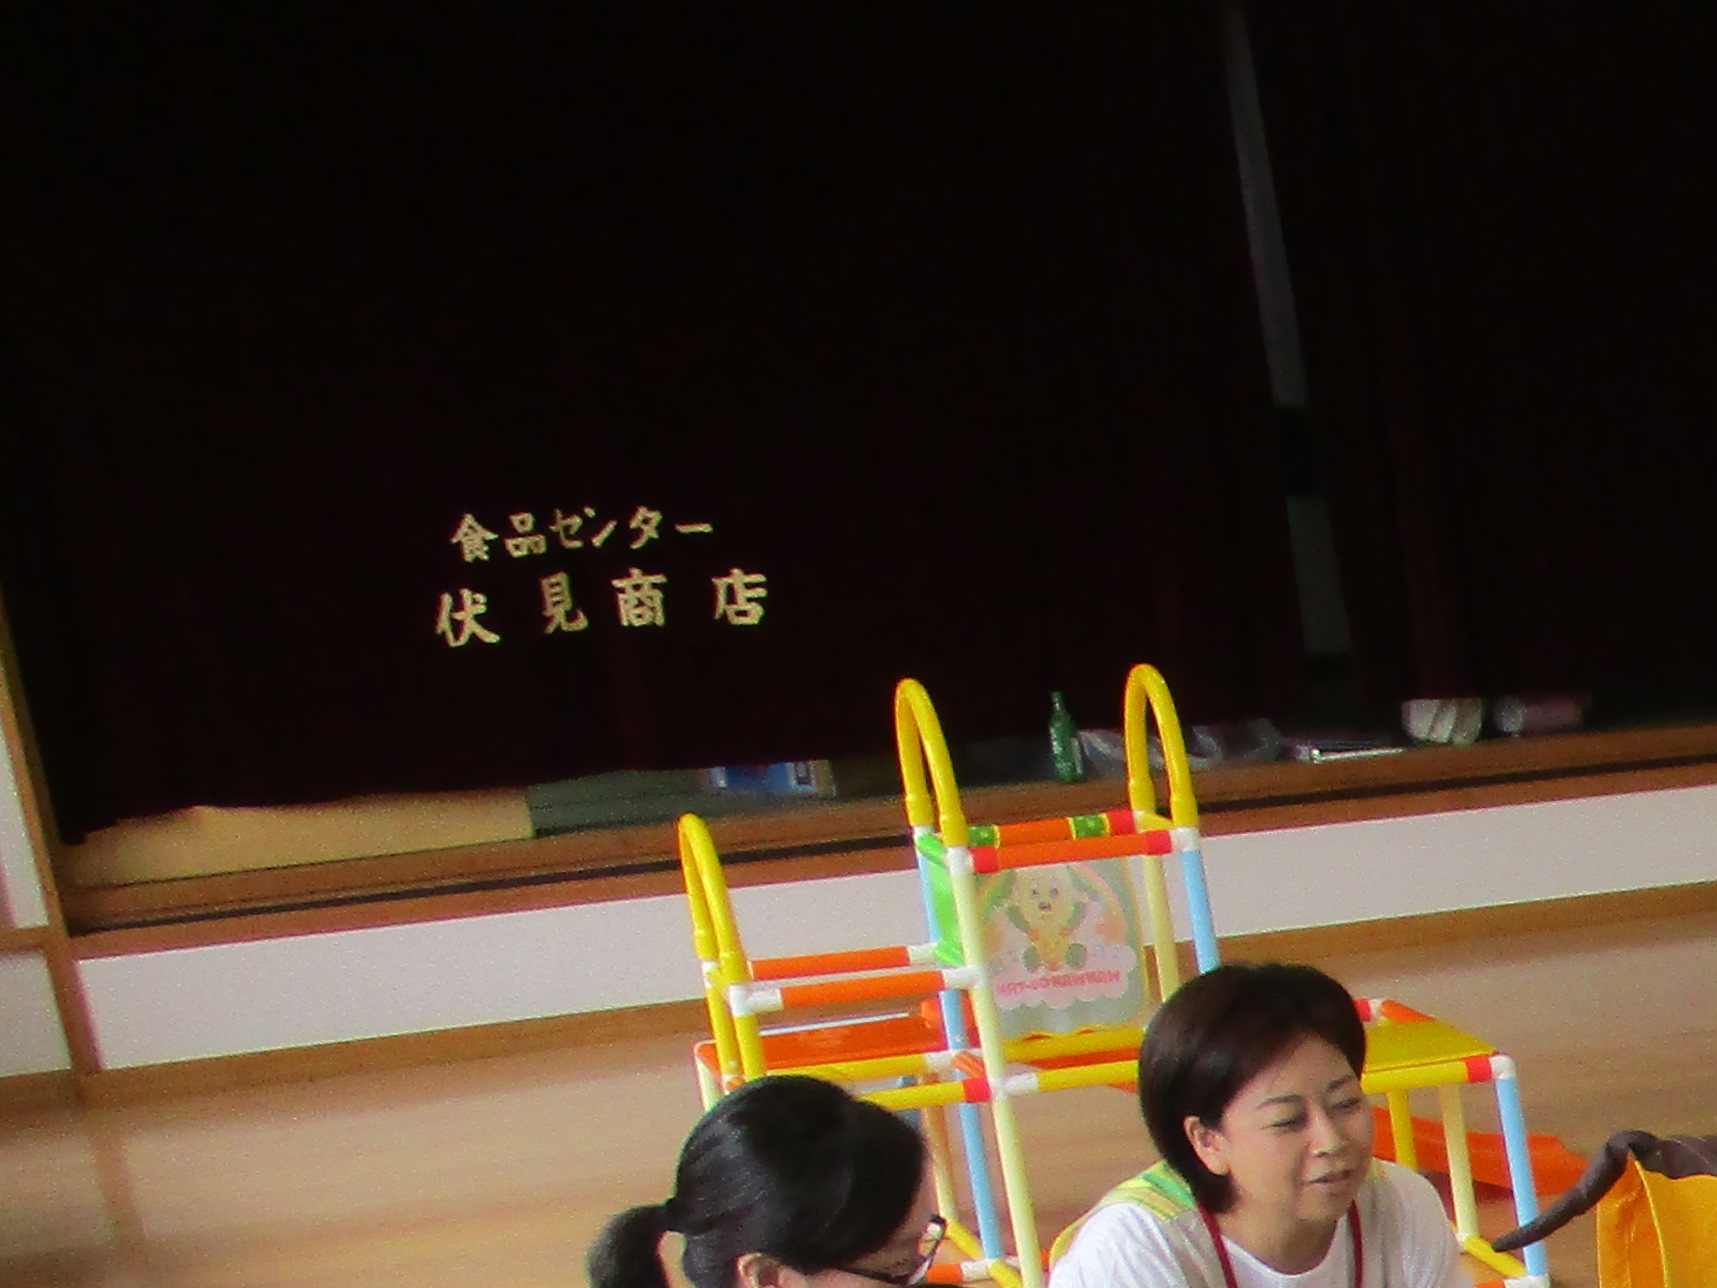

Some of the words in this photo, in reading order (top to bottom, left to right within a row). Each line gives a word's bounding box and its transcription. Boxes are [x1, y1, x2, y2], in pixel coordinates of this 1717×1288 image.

[450, 505, 714, 563] 食品センター
[435, 568, 768, 647] 伏見商店
